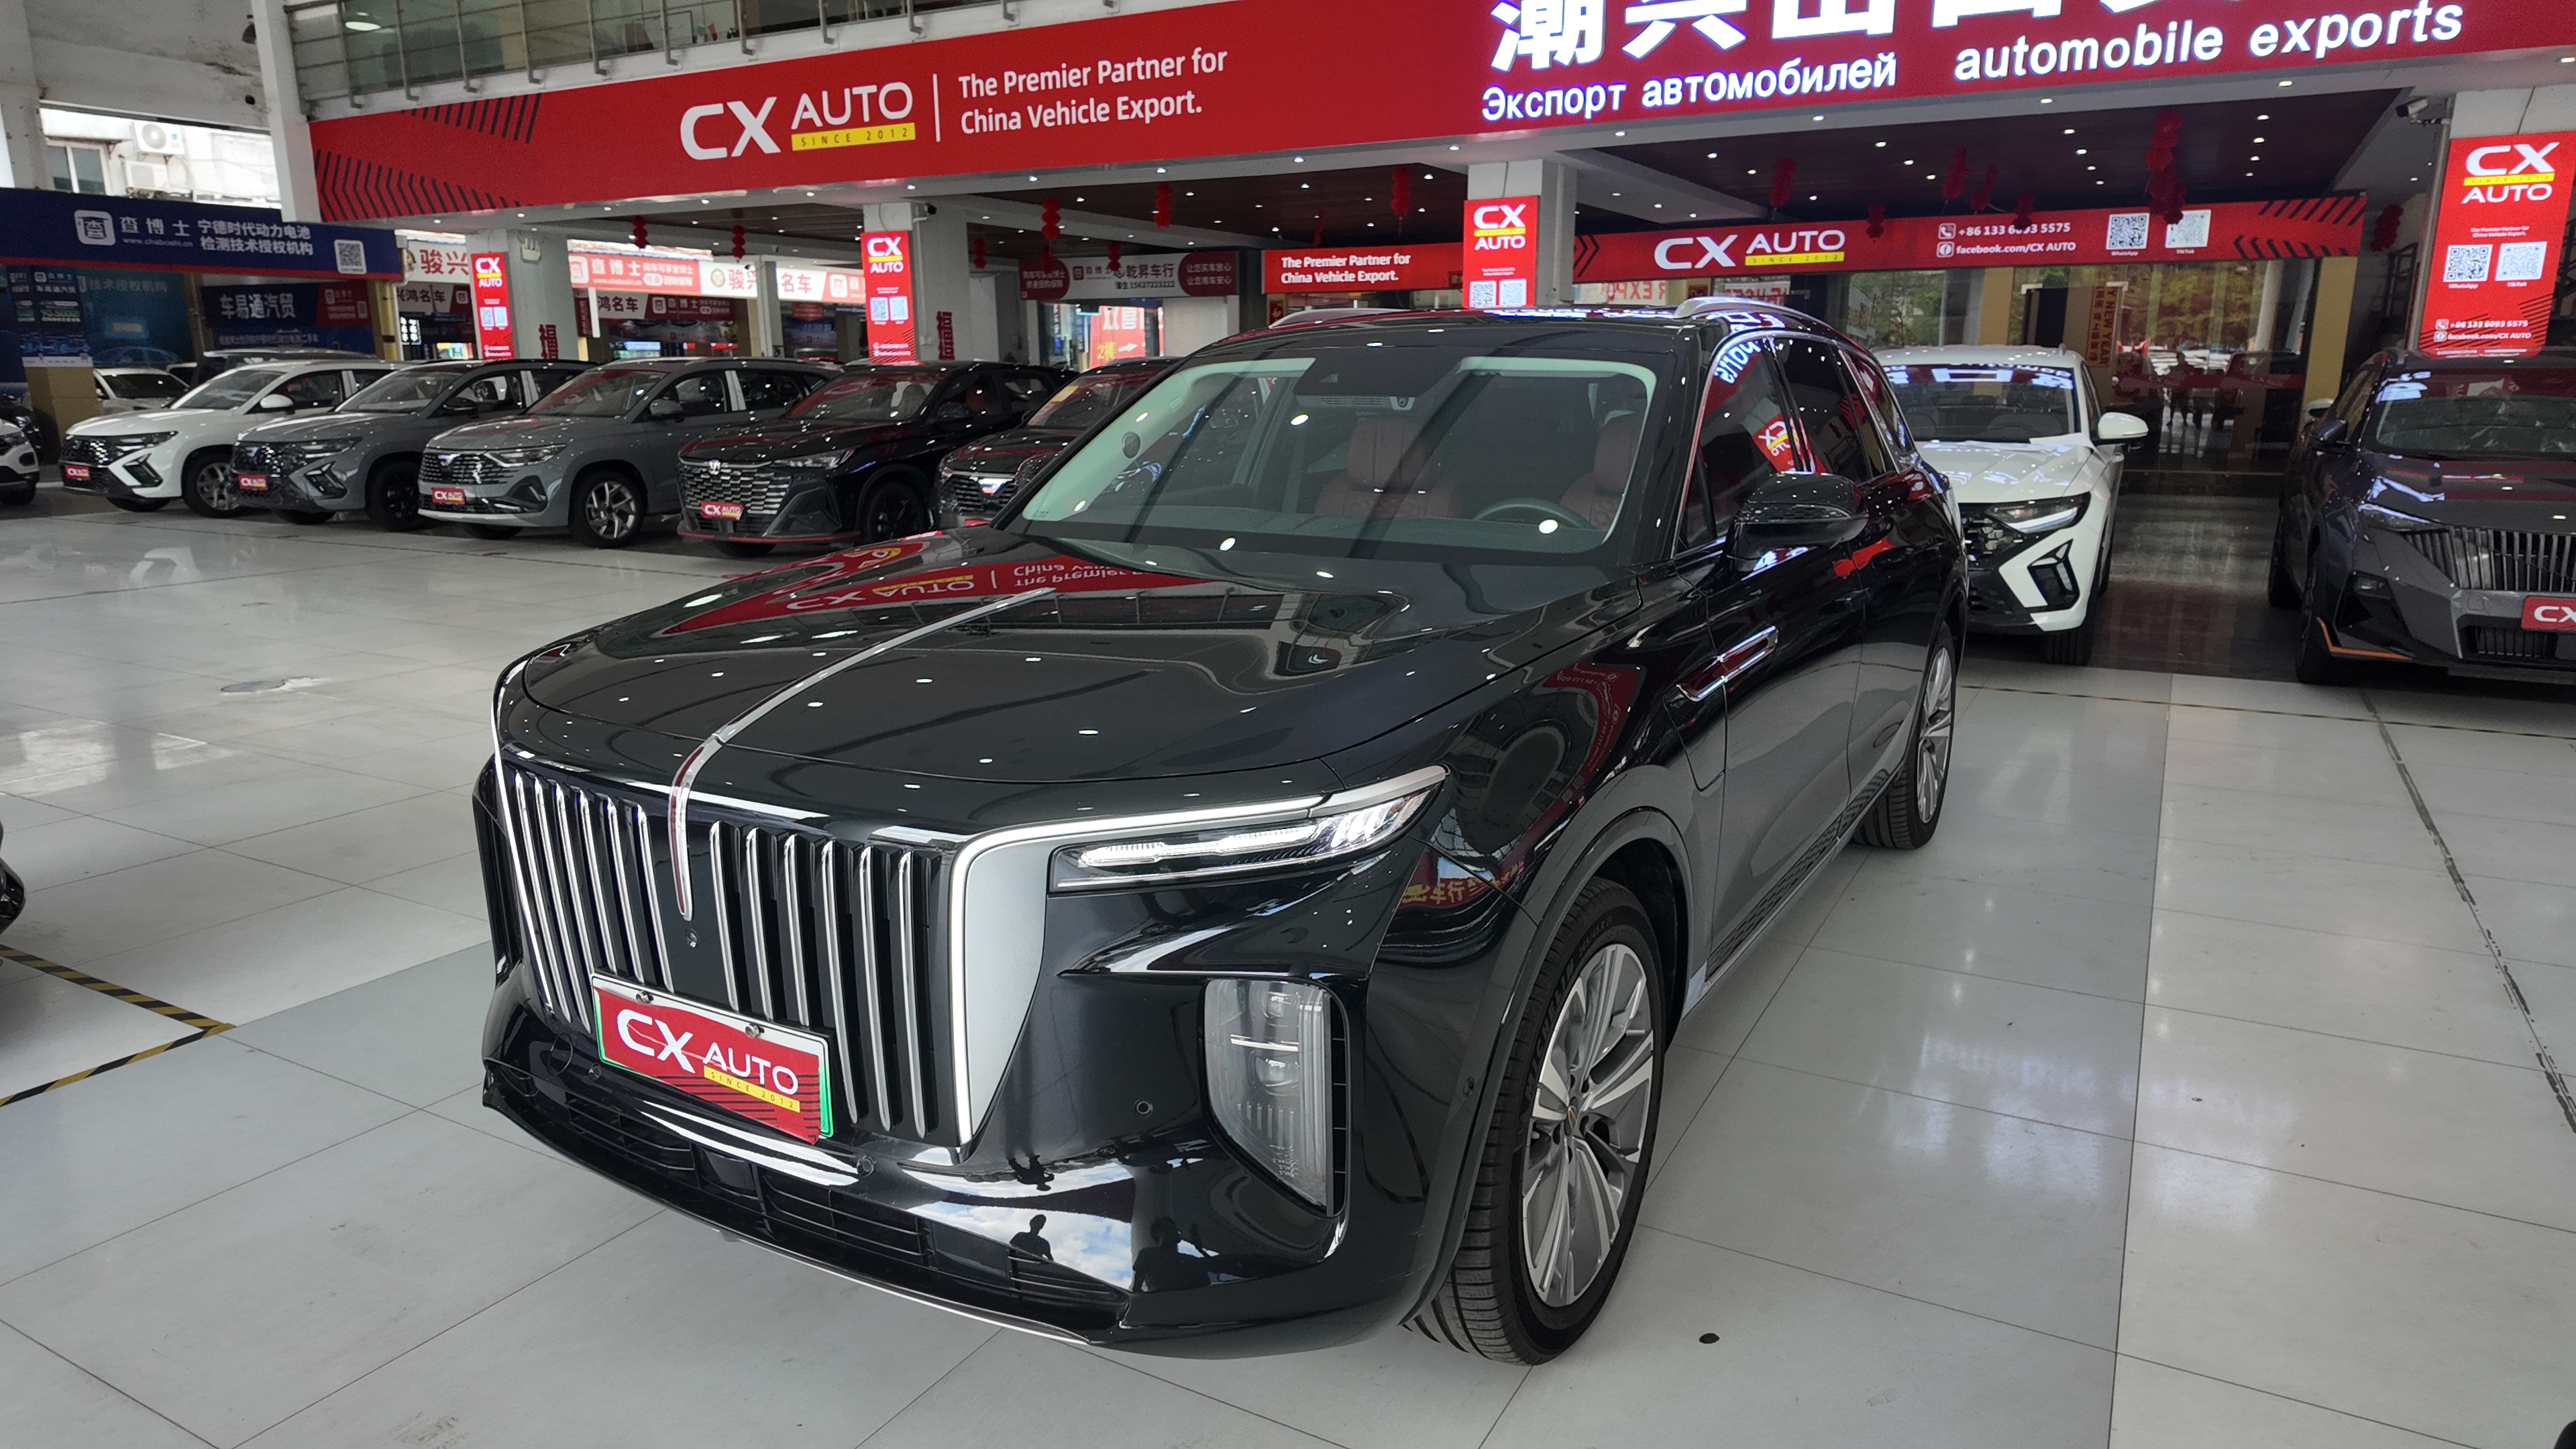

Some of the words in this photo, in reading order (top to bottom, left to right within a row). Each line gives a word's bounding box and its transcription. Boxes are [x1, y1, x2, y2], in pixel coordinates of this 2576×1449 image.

[1954, 21, 2224, 81] automobile
[2249, 3, 2464, 59] exports
[958, 72, 998, 100] The
[1004, 64, 1091, 95] Premier
[1098, 56, 1185, 86] Partner
[1191, 47, 1228, 75] for
[1482, 80, 1627, 121] Экспорт
[1642, 52, 1898, 109] автомобилей
[680, 96, 782, 161] CX
[791, 81, 914, 130] AUTO
[961, 107, 1022, 135] China
[1027, 99, 1110, 128] Vehicle
[1117, 91, 1203, 123] Export.
[800, 131, 852, 147] SINCE
[866, 126, 909, 142] 2012
[2466, 142, 2561, 176] CX
[2461, 184, 2553, 204] AUTO
[1474, 204, 1526, 229] CX
[197, 219, 311, 239] 宁德时代动力电池
[1959, 226, 1982, 236] +86
[1984, 225, 2006, 235] 133
[2040, 222, 2071, 233] 5575
[200, 236, 313, 256] 检测技术授权机构
[868, 237, 903, 256] CX
[1474, 235, 1526, 251] AUTO
[1654, 234, 1739, 270] CX
[1746, 229, 1845, 254] AUTO
[1956, 243, 2044, 255] facebook.com/CX
[2046, 241, 2076, 252] AUTO
[476, 257, 501, 274] CX
[591, 258, 641, 276] 查博士
[870, 262, 904, 273] AUTO
[1281, 258, 1301, 268] The
[1303, 256, 1347, 268] Premier
[1348, 254, 1391, 266] Partner
[1393, 253, 1411, 265] for
[1805, 254, 1839, 262] 2012
[478, 278, 502, 287] AUTO
[1281, 272, 1313, 284] China
[1315, 270, 1356, 283] Vehicle
[1357, 270, 1399, 284] Export.
[219, 292, 296, 319] 车易通汽贸
[2507, 319, 2528, 327] 5575
[2099, 333, 2112, 365] YEAR
[435, 491, 447, 500] CX
[704, 504, 721, 516] CX
[2534, 605, 2576, 623] CX
[617, 1009, 696, 1074] CX
[703, 1042, 799, 1095] AUTO
[710, 1071, 751, 1093] SINCE
[761, 1090, 794, 1109] 2012
